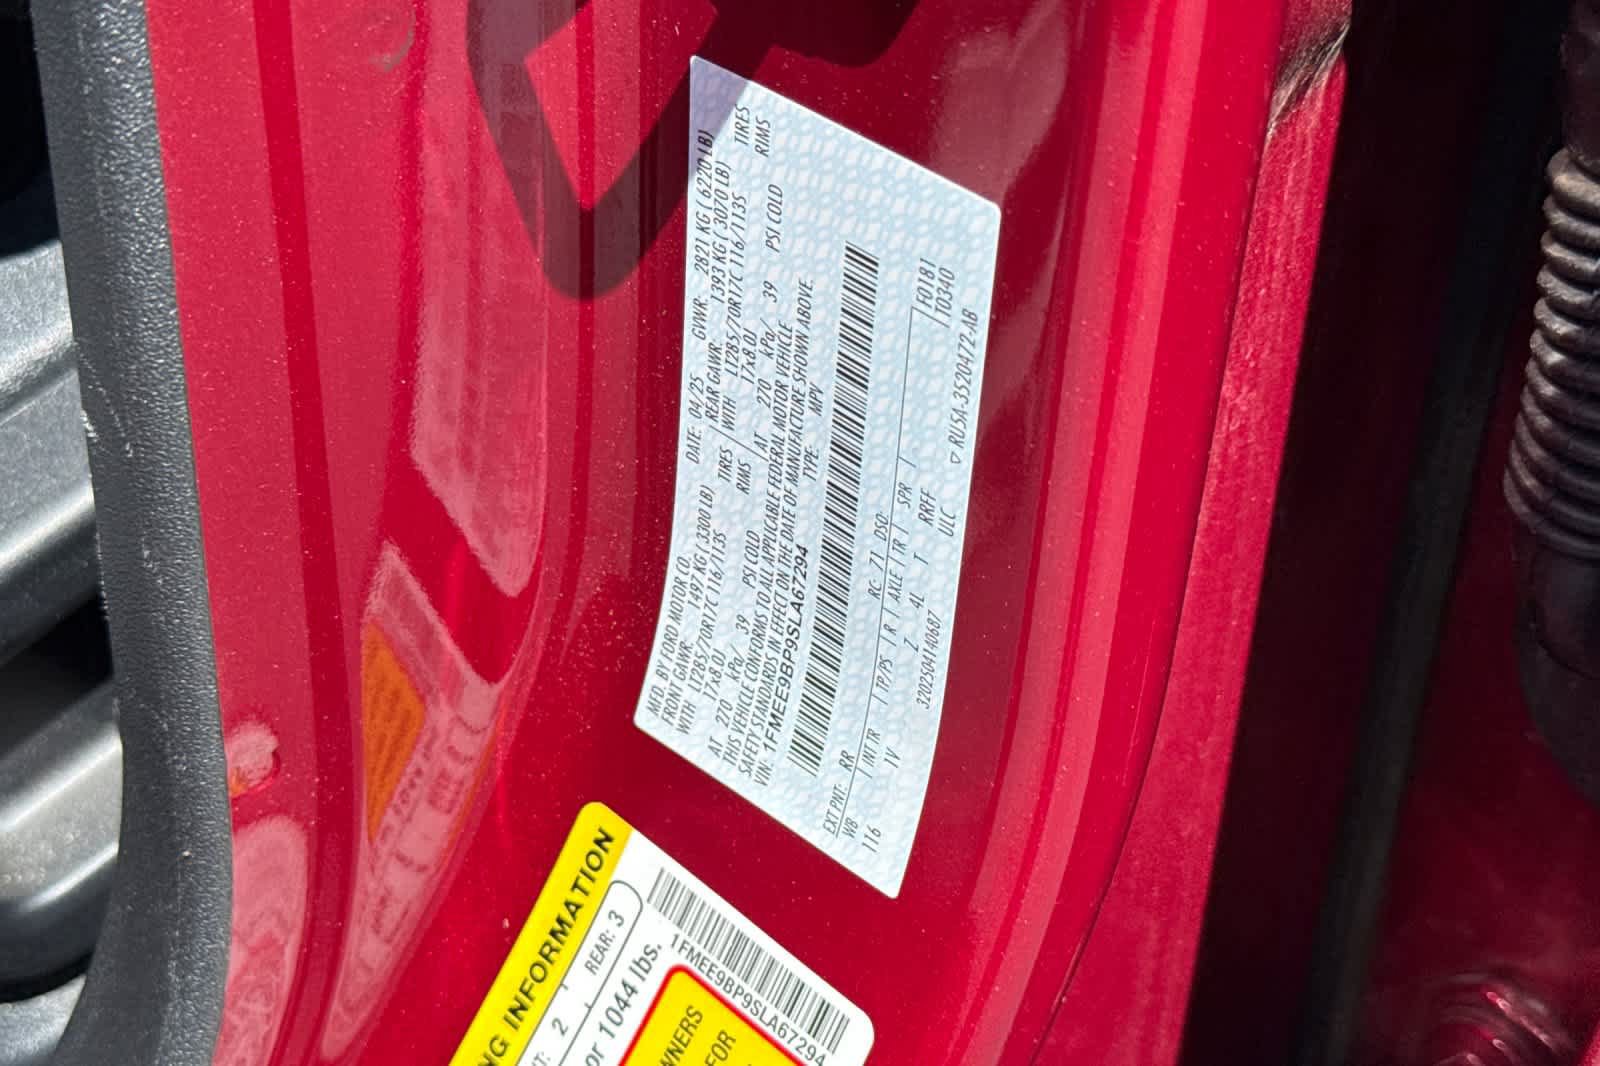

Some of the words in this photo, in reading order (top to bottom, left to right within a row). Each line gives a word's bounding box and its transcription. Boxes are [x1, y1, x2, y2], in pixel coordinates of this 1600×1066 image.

[698, 130, 716, 156] LB)
[696, 158, 712, 198] 6220
[715, 161, 731, 187] LB)
[713, 188, 728, 230] 3070
[767, 184, 783, 224] COLD
[696, 211, 711, 234] KG
[766, 226, 780, 253] PSI
[694, 238, 710, 276] 2821
[712, 241, 727, 264] KG
[721, 395, 736, 431] WITH
[734, 104, 750, 146] TIRES
[740, 328, 757, 384] 17x8.0J
[755, 116, 770, 157] RIMS
[710, 266, 726, 304] 1393
[763, 281, 778, 303] 39
[916, 258, 936, 309] F0181
[934, 267, 955, 317] T0340
[691, 296, 708, 340] GVWR:
[797, 278, 813, 330] ABOVE.
[759, 318, 777, 359] kPa/
[776, 320, 792, 378] VEHICLE
[707, 340, 723, 385] GAWR:
[792, 330, 809, 385] SHOWN
[688, 373, 704, 419] 04/25
[705, 386, 720, 423] REAR
[756, 378, 772, 408] 270
[772, 380, 789, 431] MOTOR
[808, 382, 824, 416] MPV
[686, 428, 702, 464] DATE:
[754, 431, 768, 453] AT
[785, 385, 806, 487] MANUFACTURE
[768, 433, 785, 490] FEDERAL
[803, 446, 819, 482] TYPE:
[699, 485, 715, 509] LB)
[783, 486, 797, 507] OF
[897, 482, 912, 509] SPR
[918, 488, 936, 526] RRFF
[696, 508, 711, 544] 3300
[762, 489, 781, 567] APPLICABLE
[780, 506, 796, 542] DATE
[693, 554, 707, 575] KG
[744, 530, 760, 565] COLD
[778, 541, 792, 568] THE
[869, 550, 884, 571] 71
[892, 538, 907, 555] TR
[914, 552, 928, 565] T
[676, 556, 691, 575] CO.
[703, 648, 726, 701] 17x8.0J
[736, 459, 751, 495] RIMS
[742, 565, 757, 589] PSI
[759, 568, 774, 592] ALL
[776, 568, 790, 591] ON
[668, 576, 688, 624] MOTOR
[676, 700, 696, 735] WITH
[718, 445, 733, 483] TIRES
[688, 575, 704, 610] 1497
[756, 592, 770, 610] TO
[887, 569, 903, 603] AXLE
[909, 592, 924, 608] 4L
[736, 614, 750, 635] 39
[770, 590, 788, 636] EFFECT
[916, 609, 941, 709] 3202504140687
[937, 506, 956, 536] ULC
[660, 625, 679, 662] FORD
[673, 640, 694, 681] GAWR:
[744, 611, 768, 682] CONFORMS
[763, 544, 808, 752] 1FMEE9BP9SLA67294
[767, 636, 781, 654] IN
[656, 659, 670, 681] BY
[724, 644, 745, 683] kPa/
[876, 654, 893, 692] TP/PS
[646, 685, 666, 716] MFD.
[661, 681, 683, 726] FRONT
[731, 681, 755, 733] VEHICLE
[751, 652, 778, 729] STANDARDS
[716, 699, 733, 728] 270
[708, 736, 722, 758] AT
[723, 735, 741, 766] THIS
[738, 728, 761, 777] SAFETY
[866, 728, 880, 744] TR
[755, 760, 774, 786] VIN:
[839, 750, 855, 772] RR
[862, 744, 877, 767] INT
[884, 747, 900, 768] 1V
[830, 784, 847, 807] PNT:
[823, 809, 839, 834] EXT
[842, 817, 858, 838] WB
[862, 825, 881, 853] 116
[503, 826, 614, 1031] INFORMATION
[552, 1017, 569, 1036] 2
[584, 929, 616, 976] REAR:
[608, 909, 625, 928] 3
[585, 1042, 604, 1066] or
[599, 979, 638, 1039] 1044
[628, 943, 663, 982] lbs.
[670, 933, 826, 1066] 1FMEE9BP9SLA67294
[704, 1029, 736, 1066] FOR
